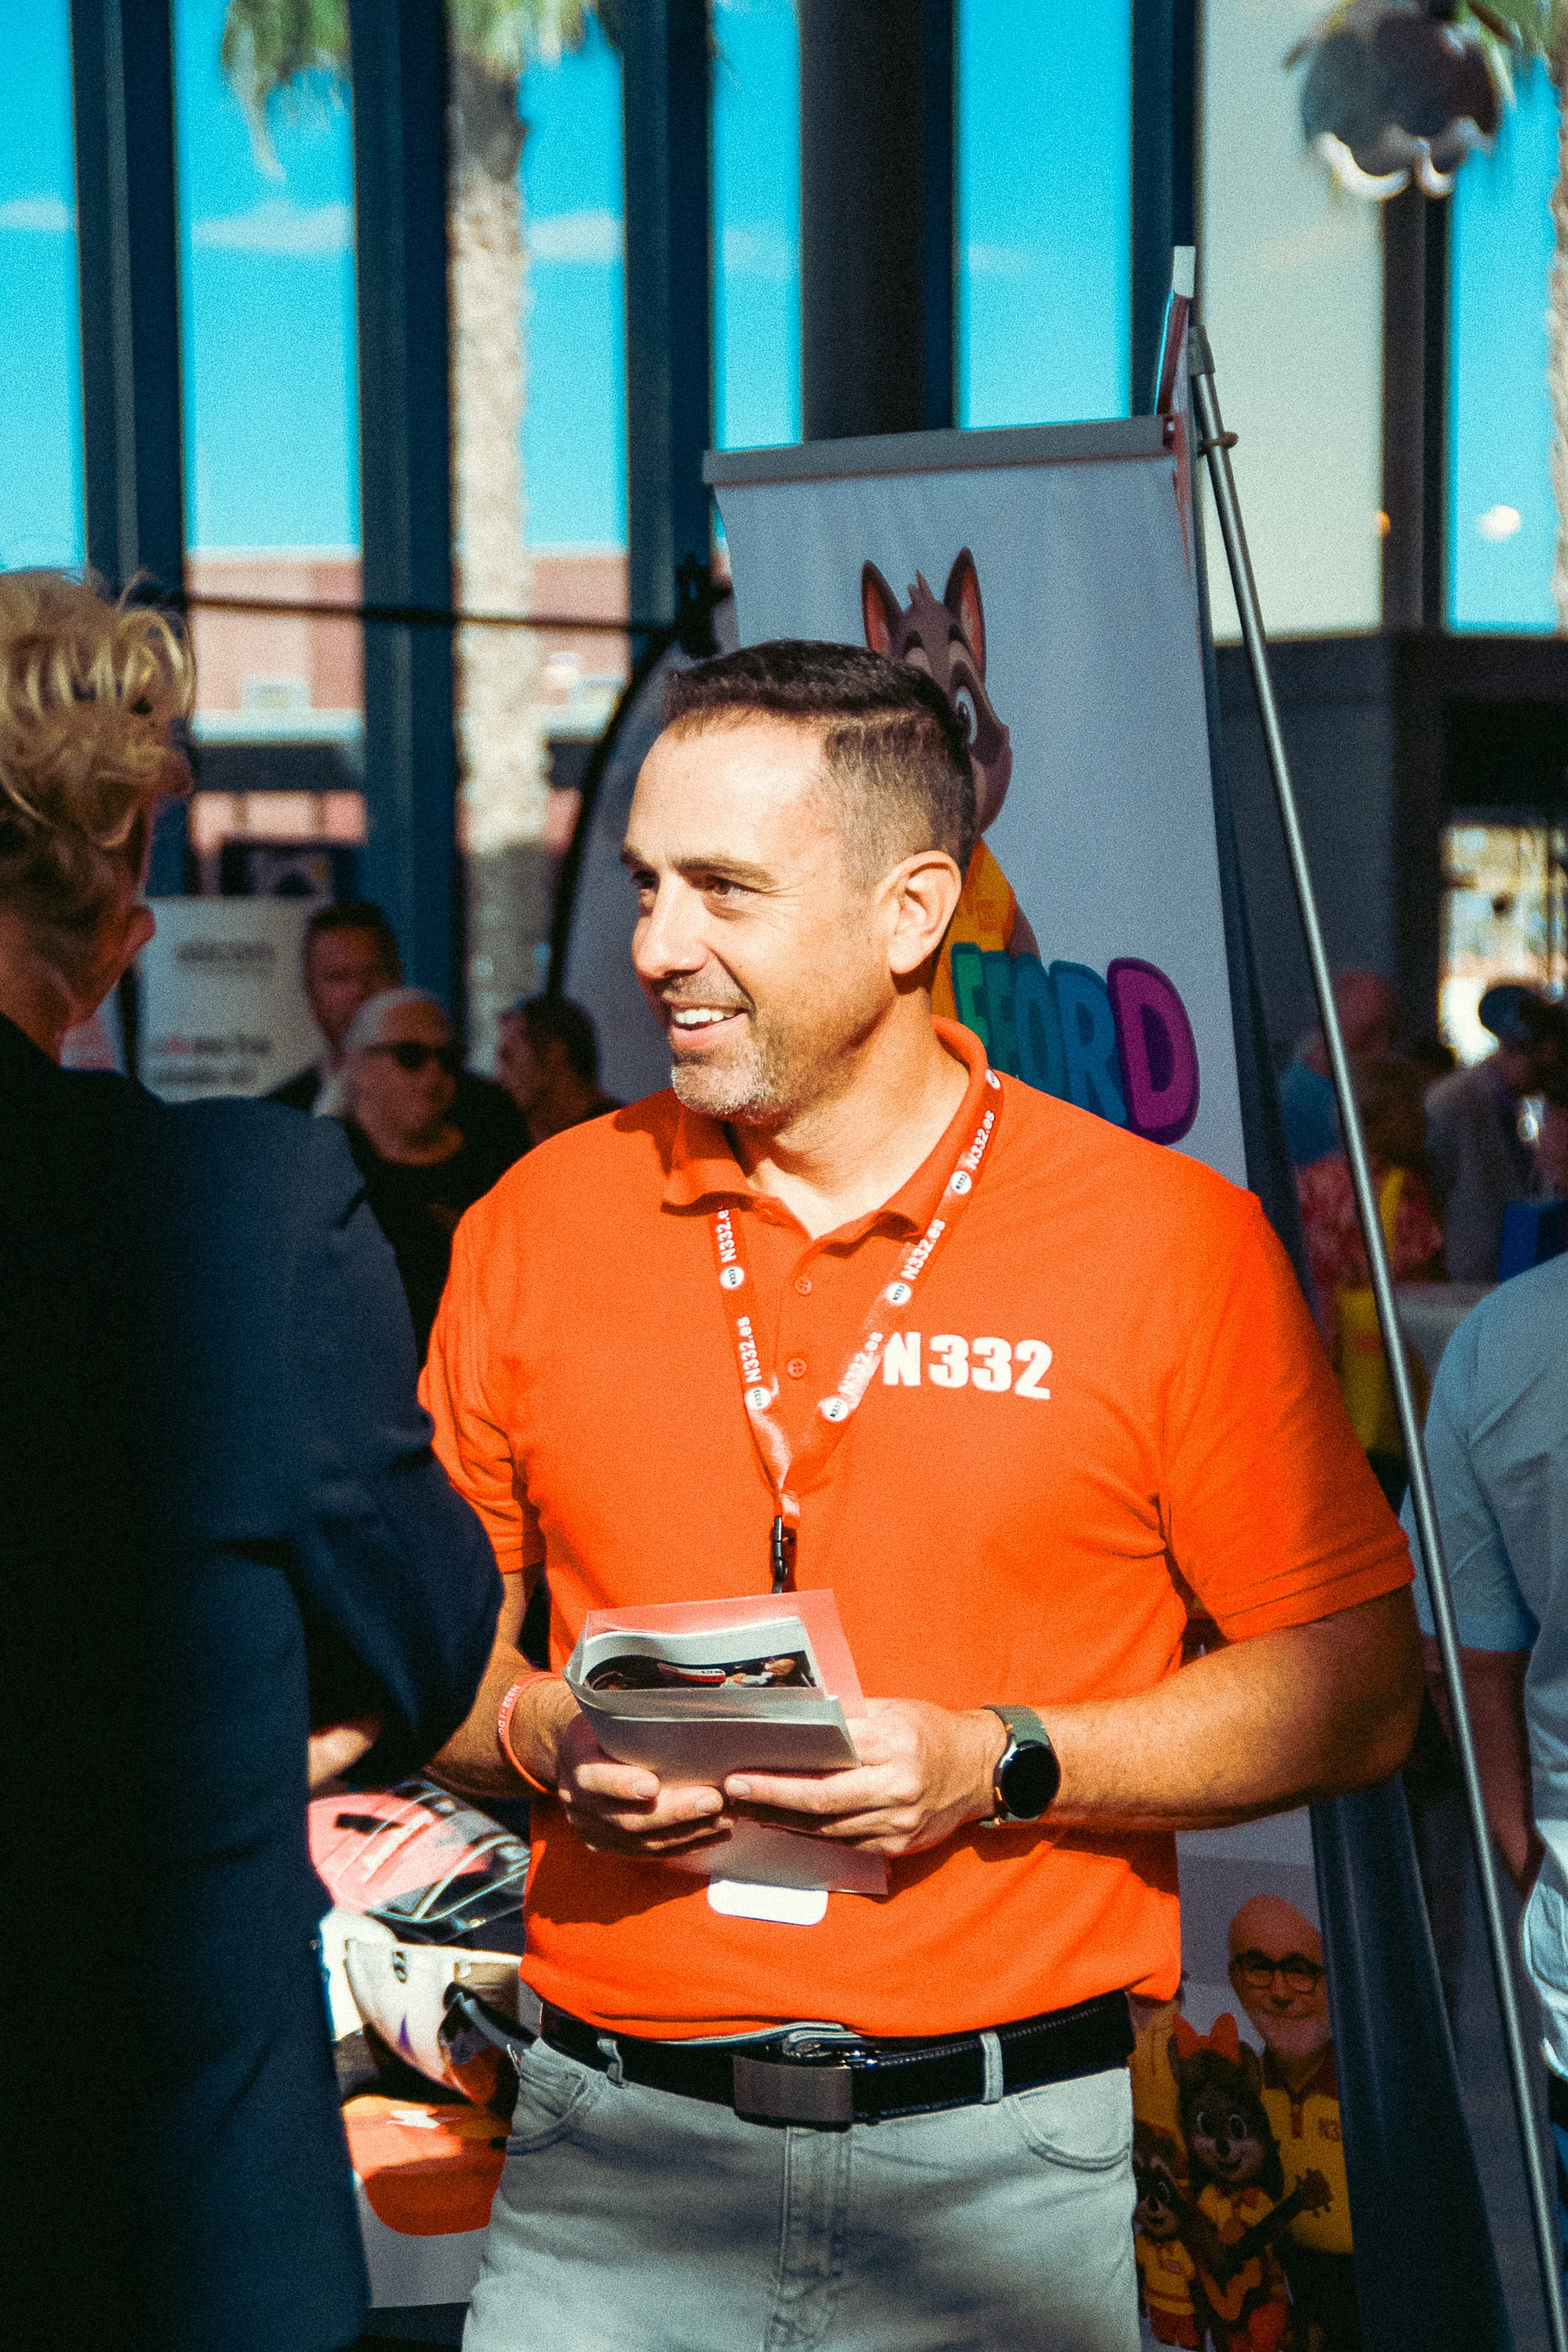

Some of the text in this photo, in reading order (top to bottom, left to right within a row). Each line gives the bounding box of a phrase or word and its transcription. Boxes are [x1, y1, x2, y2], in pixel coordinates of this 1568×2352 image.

[965, 1110, 995, 1171] N332.es
[717, 1205, 737, 1263] N332.e
[900, 1219, 945, 1280] N332.es
[736, 1316, 762, 1382] N332.es
